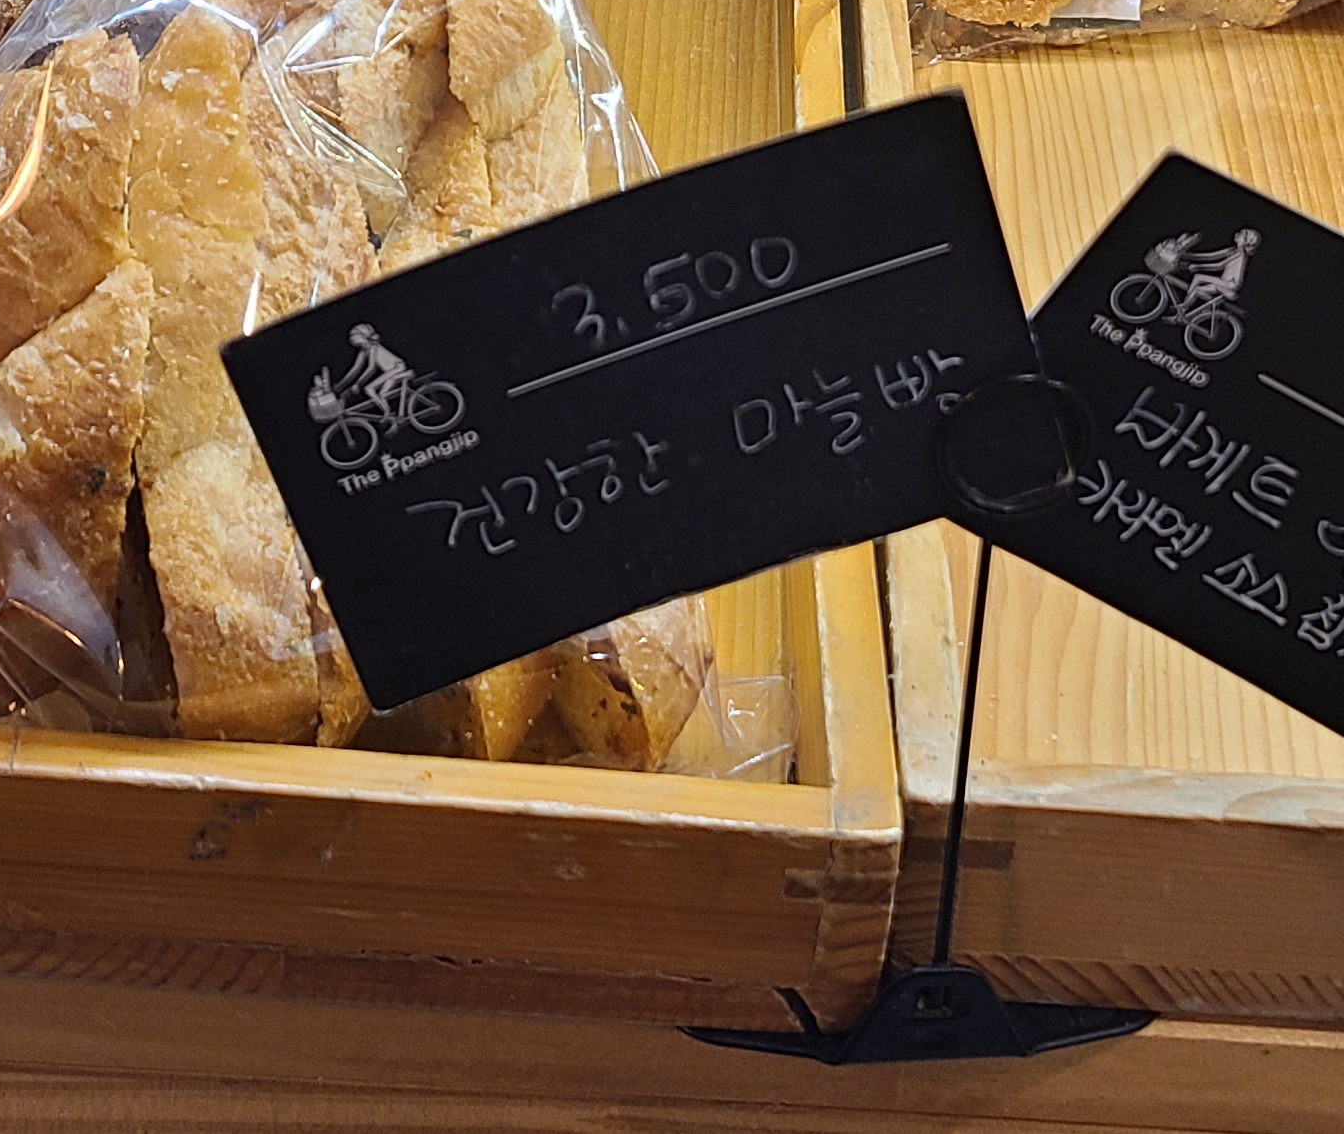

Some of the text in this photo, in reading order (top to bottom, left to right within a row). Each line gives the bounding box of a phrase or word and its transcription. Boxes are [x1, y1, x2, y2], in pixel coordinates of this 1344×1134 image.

[1089, 313, 1211, 388] The Ppangjip
[337, 429, 481, 496] The Ppangjip
[405, 431, 670, 555] 건강한
[1114, 385, 1300, 529] 바게트
